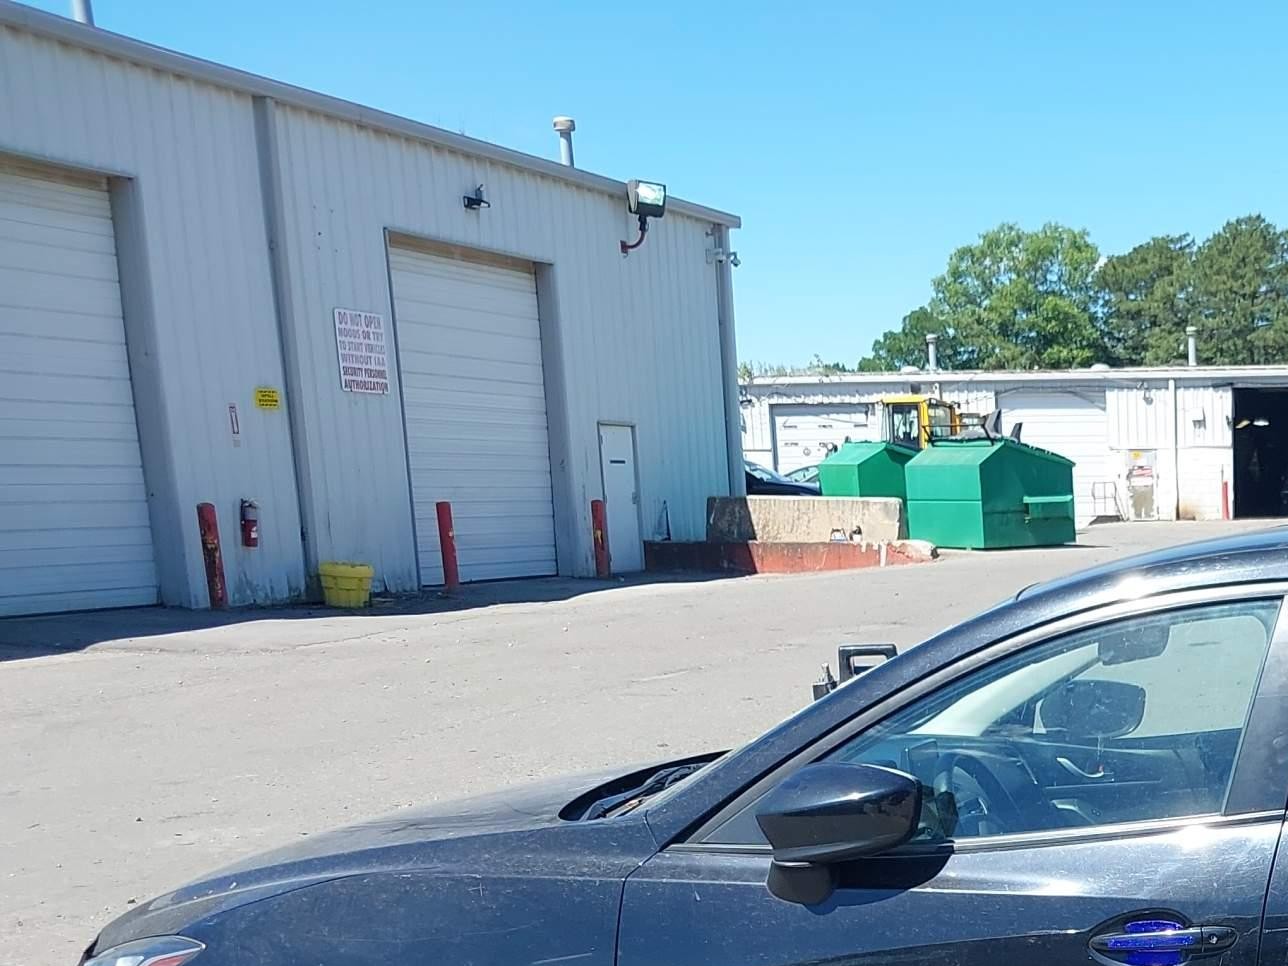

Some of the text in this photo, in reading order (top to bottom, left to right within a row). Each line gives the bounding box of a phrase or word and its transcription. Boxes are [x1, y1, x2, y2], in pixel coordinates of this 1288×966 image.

[338, 311, 382, 330] DO NOT OPEN
[362, 330, 371, 341] OR
[339, 340, 347, 351] TO
[343, 366, 362, 378] SECURITY
[344, 378, 389, 393] AUTHORIZATION
